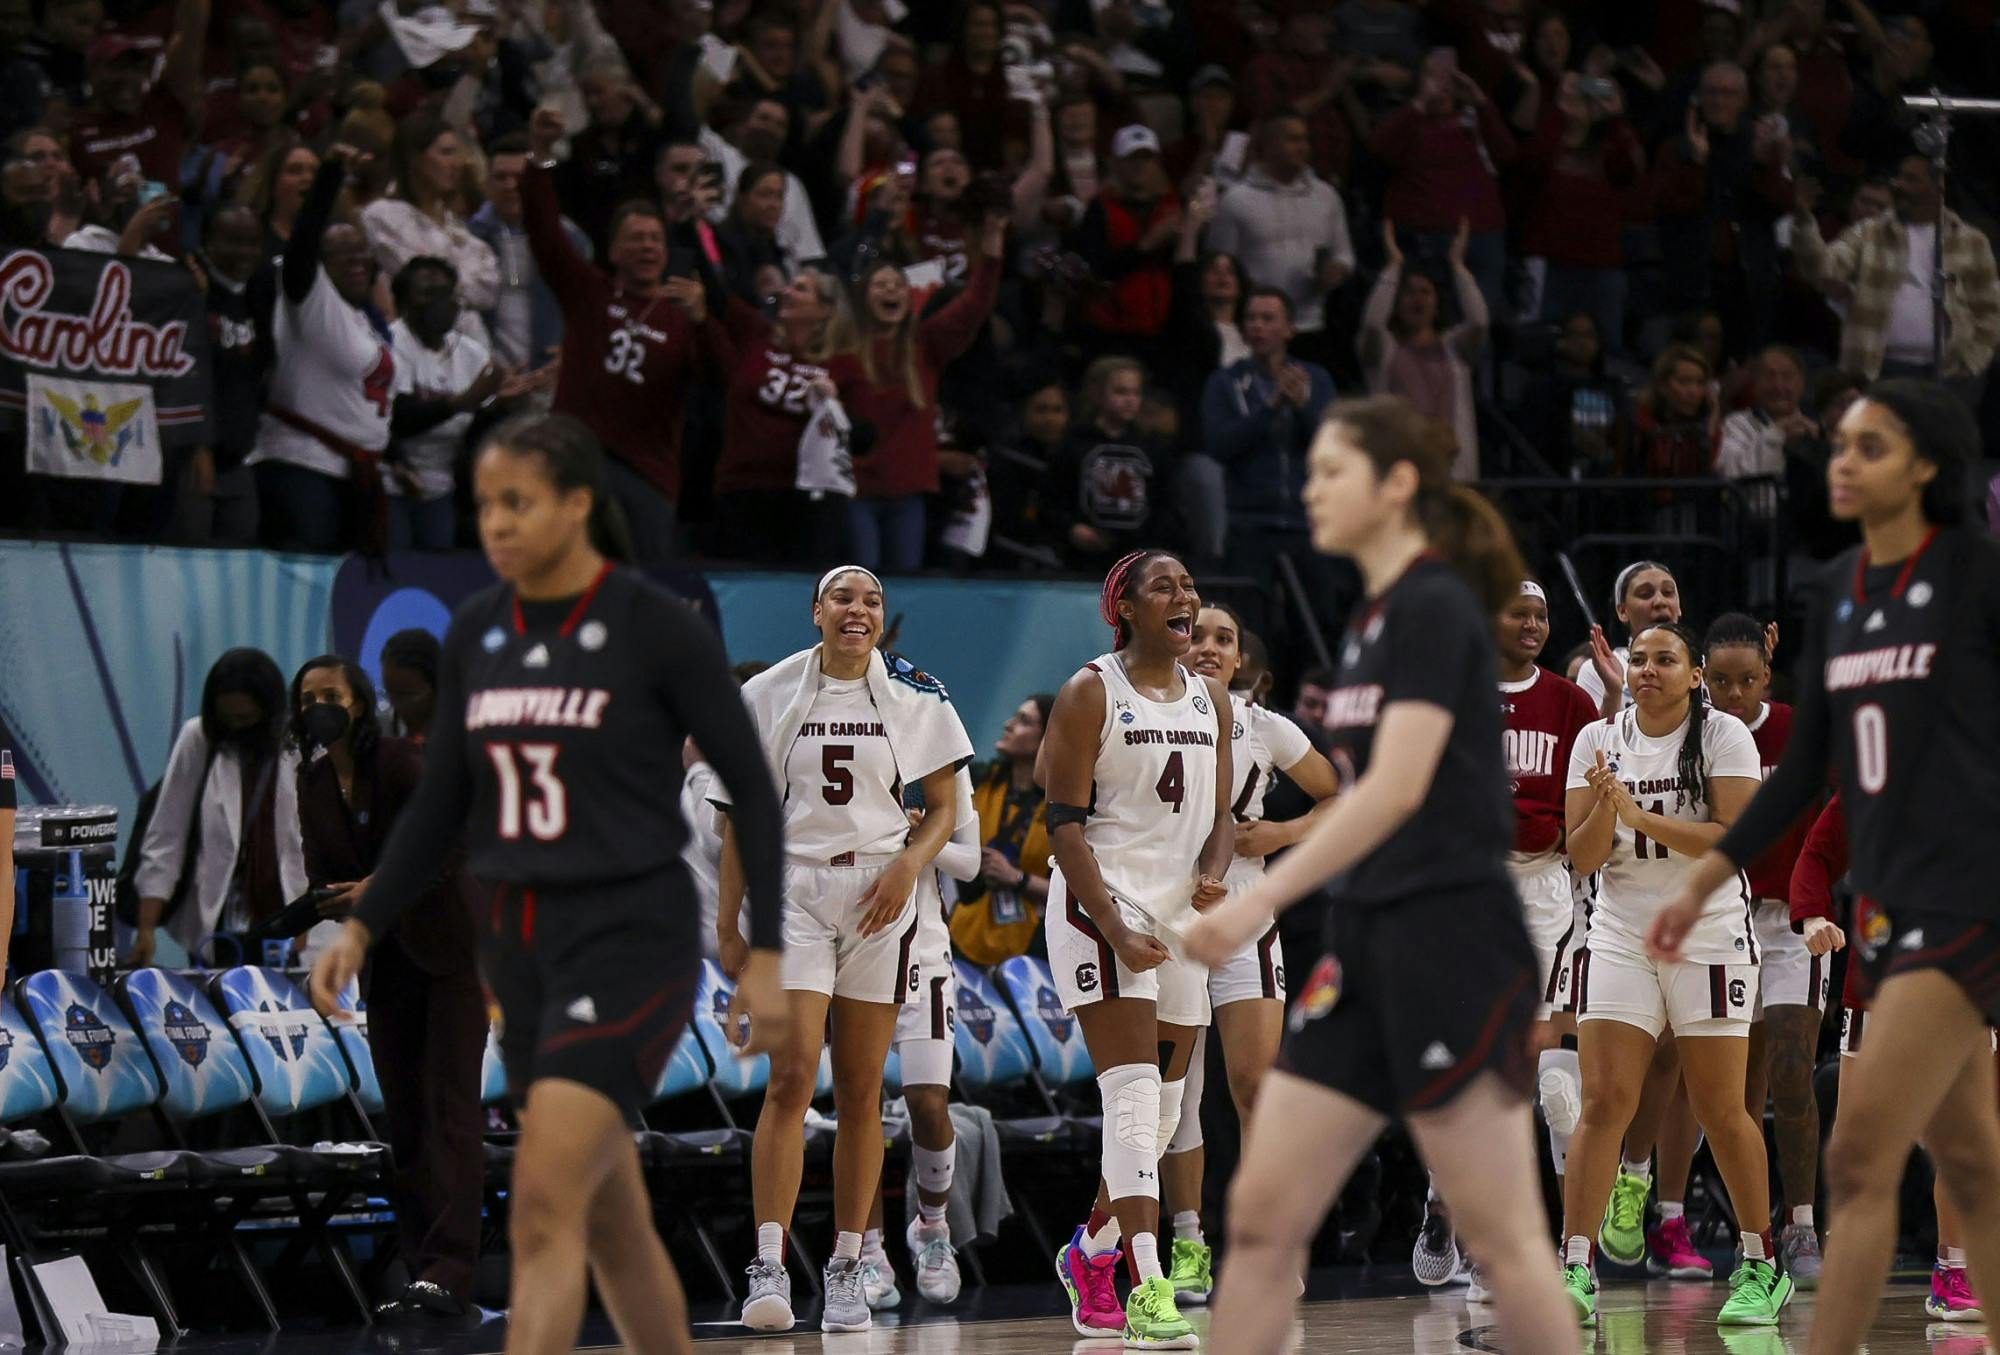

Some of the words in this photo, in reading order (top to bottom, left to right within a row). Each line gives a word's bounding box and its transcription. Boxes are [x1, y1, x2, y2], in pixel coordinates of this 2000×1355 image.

[0, 248, 197, 378] Carolina
[364, 344, 394, 417] 4
[604, 328, 646, 385] 32
[758, 367, 811, 413] 32
[797, 722, 826, 738] UTH
[1124, 730, 1164, 746] SOUTH
[1166, 730, 1215, 748] CAROLINA
[1853, 702, 1888, 795] 0
[485, 741, 570, 844] 13
[822, 745, 854, 805] 5
[1156, 751, 1185, 813] 4
